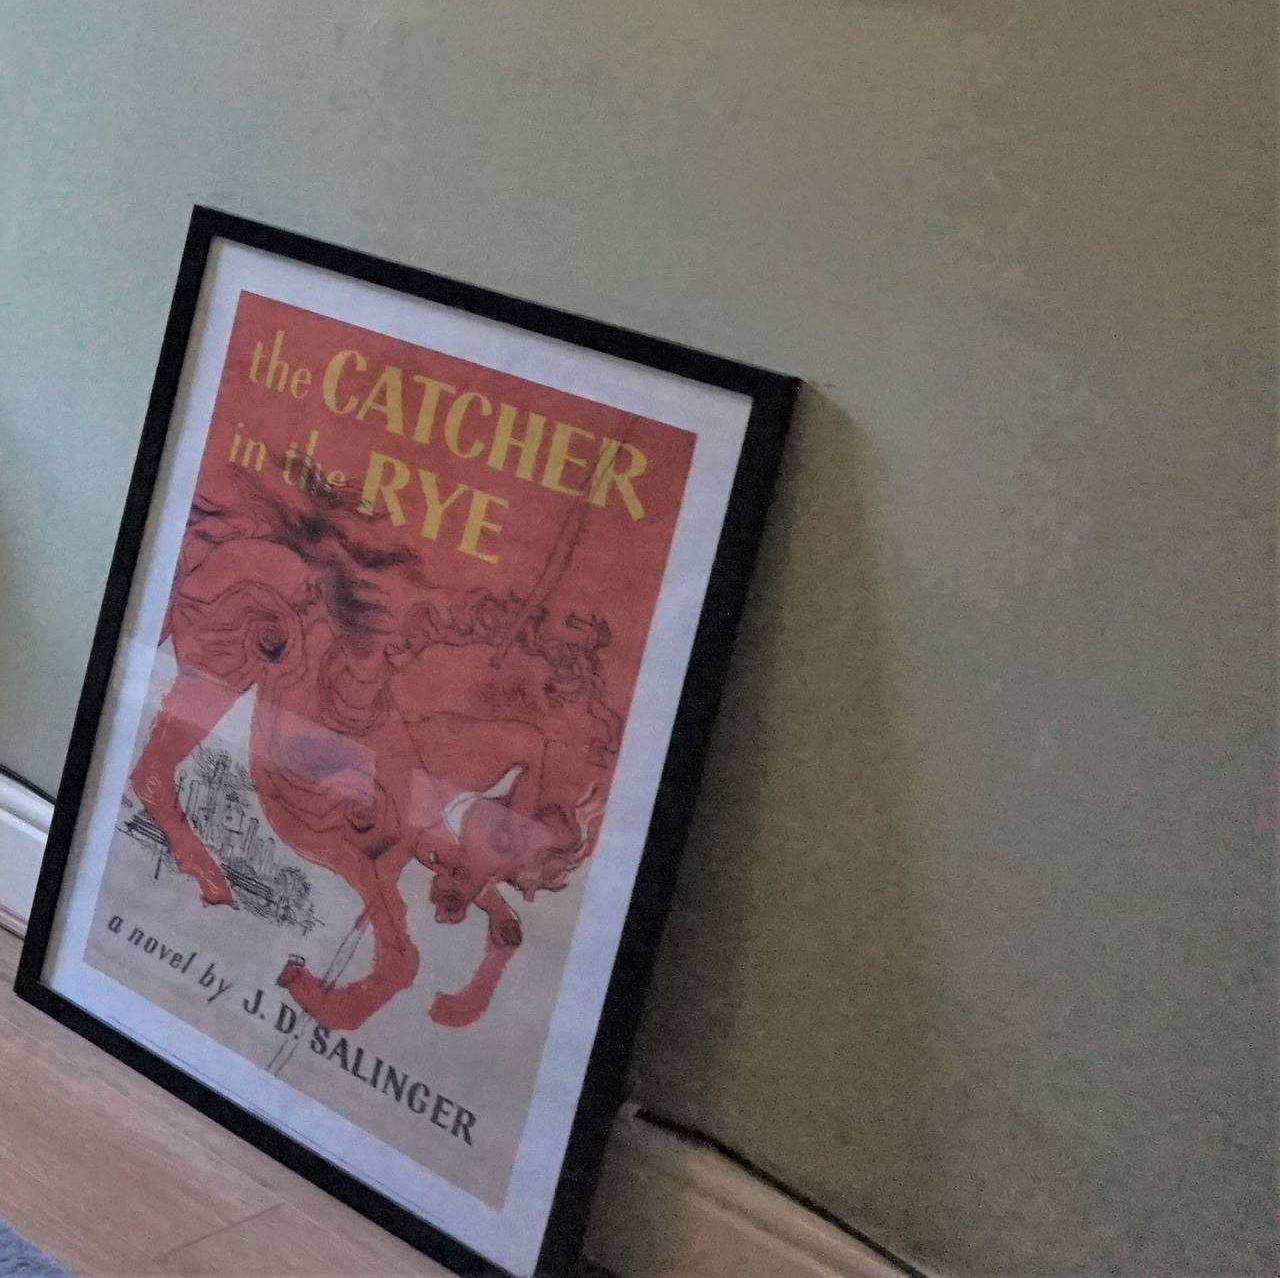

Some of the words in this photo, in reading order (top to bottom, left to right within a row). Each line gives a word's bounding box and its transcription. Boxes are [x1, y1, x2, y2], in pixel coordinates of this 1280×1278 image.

[229, 422, 267, 472] in
[356, 451, 510, 564] RYE
[249, 329, 312, 399] the
[323, 350, 648, 521] CATCHER
[108, 914, 125, 933] a
[128, 927, 197, 974] novel
[198, 962, 234, 1002] by
[243, 989, 266, 1020] J.
[311, 1026, 477, 1146] SALINGER
